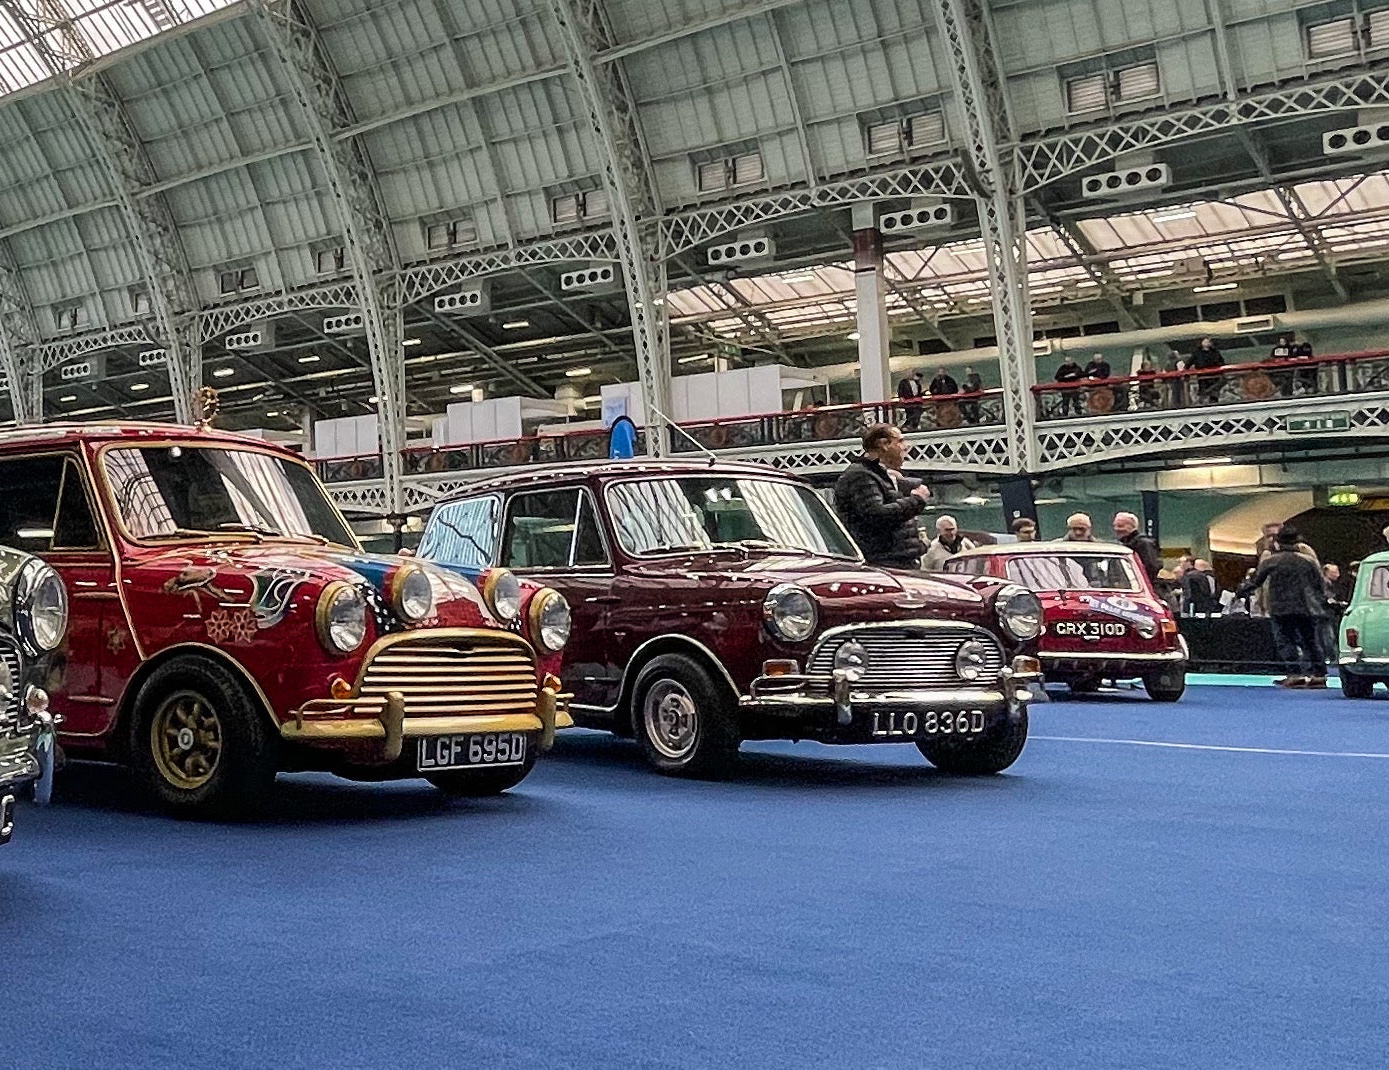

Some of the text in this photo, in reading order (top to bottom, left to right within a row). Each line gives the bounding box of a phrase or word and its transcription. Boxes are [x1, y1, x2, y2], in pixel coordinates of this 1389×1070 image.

[1056, 622, 1126, 636] GRX 310D
[873, 710, 984, 736] LLO 836D
[422, 733, 524, 766] LGF 695D
